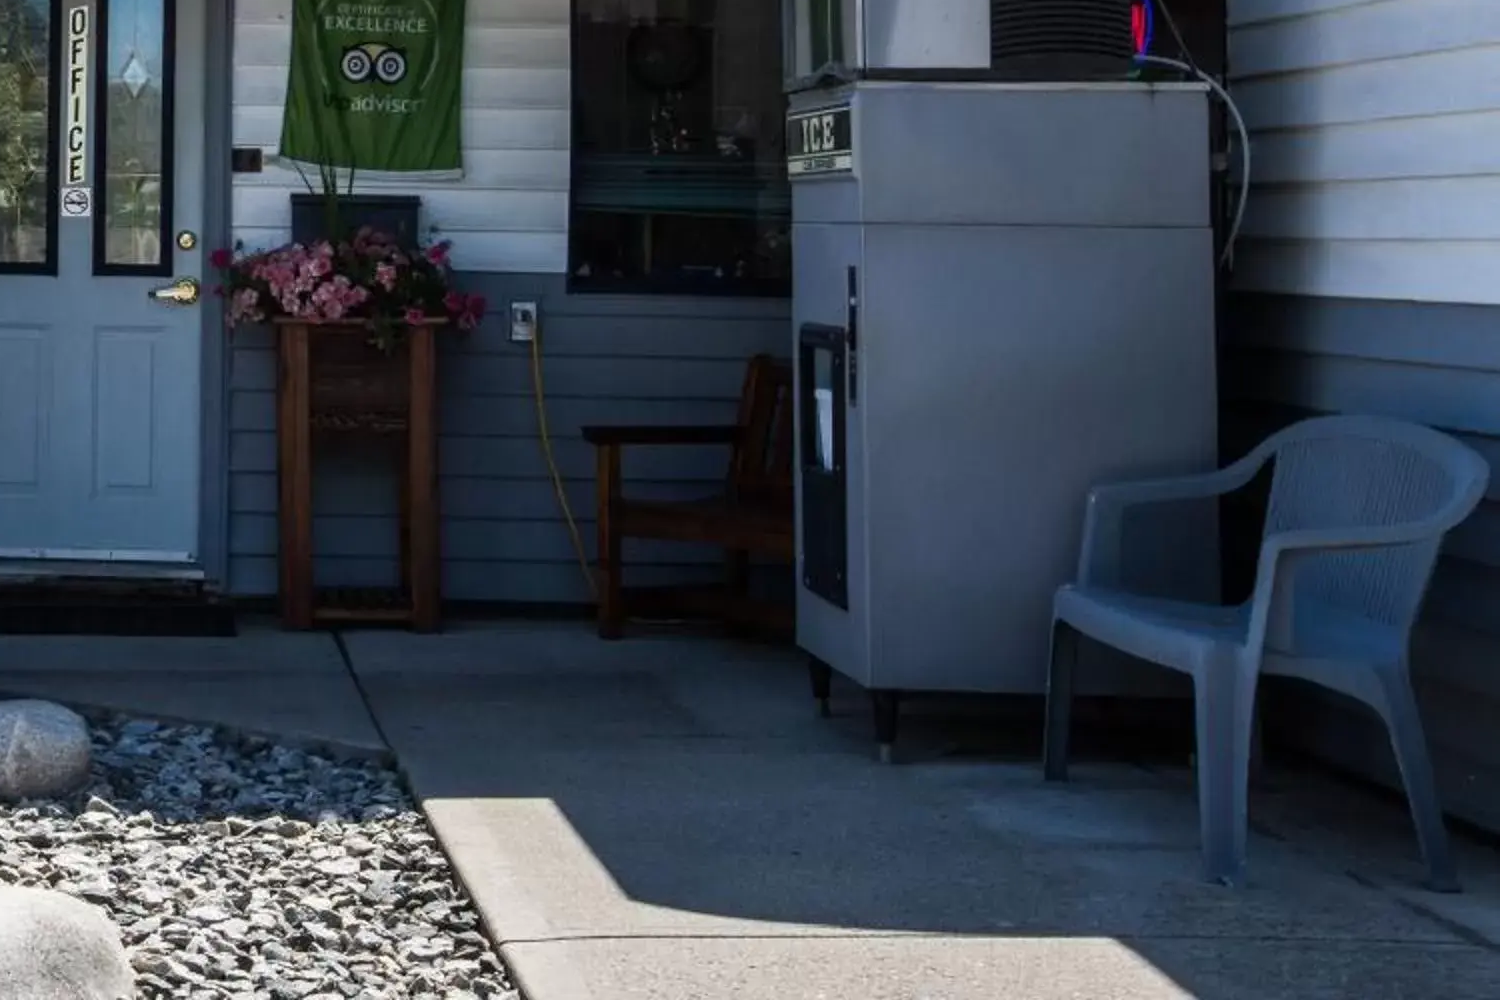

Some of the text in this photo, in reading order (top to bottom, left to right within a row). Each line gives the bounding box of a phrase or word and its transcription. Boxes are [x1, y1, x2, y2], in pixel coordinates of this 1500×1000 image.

[324, 16, 428, 33] EXCELLENCE
[68, 9, 86, 182] OFFICE
[802, 115, 835, 153] ICE
